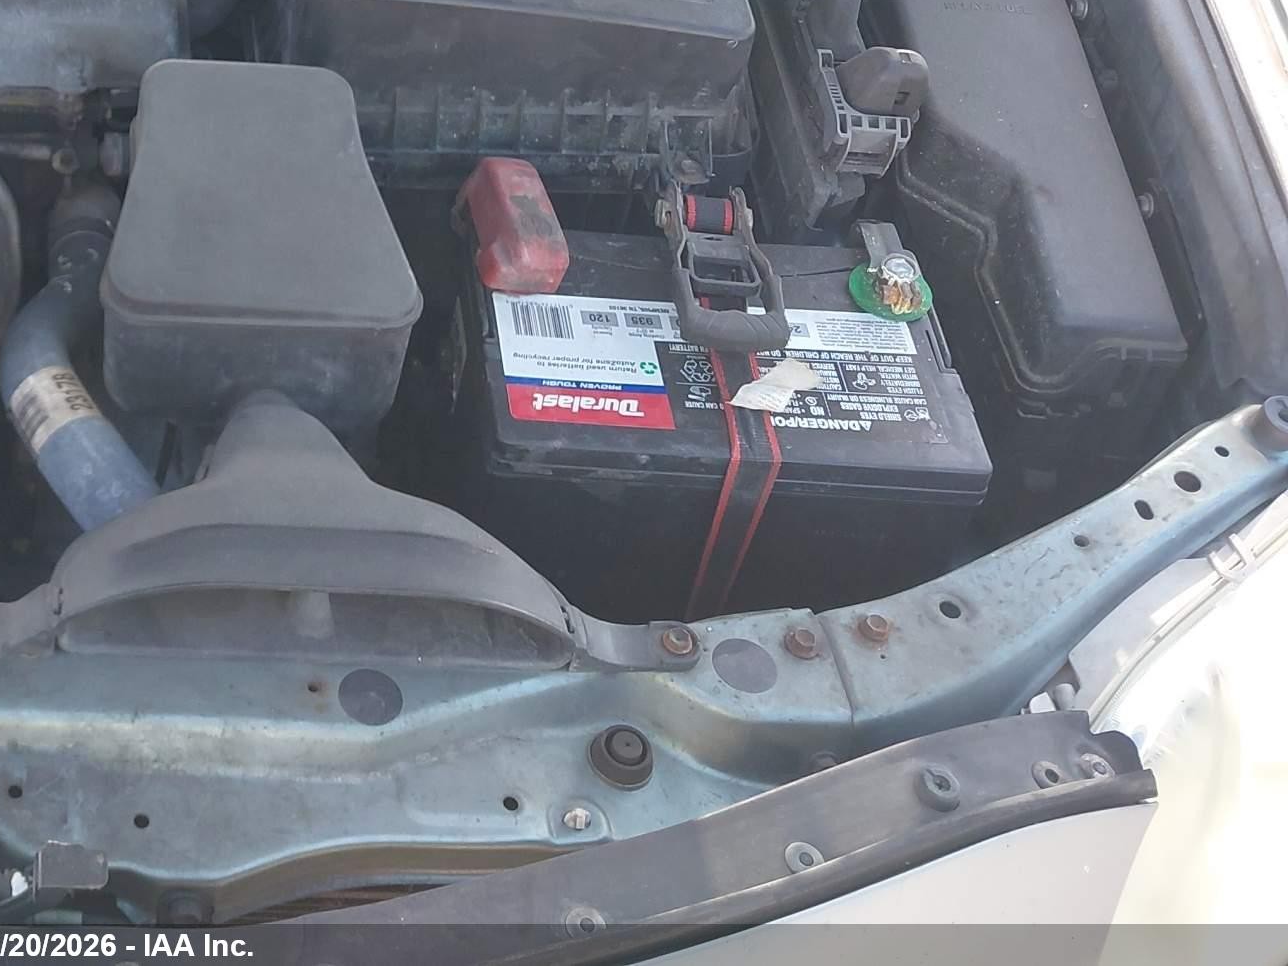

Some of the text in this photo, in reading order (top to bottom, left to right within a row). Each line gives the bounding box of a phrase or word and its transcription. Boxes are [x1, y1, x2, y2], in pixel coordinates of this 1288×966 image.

[589, 314, 654, 326] 935 120
[513, 352, 550, 362] recycling
[552, 355, 580, 363] proper
[869, 354, 879, 362] OF
[879, 355, 894, 363] OUT
[895, 355, 913, 363] KEEP
[548, 362, 584, 371] batteries
[586, 364, 606, 372] used
[541, 380, 622, 390] PROVEN TOUGH
[532, 393, 645, 417] Duralast
[860, 412, 877, 420] EYES
[770, 415, 861, 431] DANGER/POI
